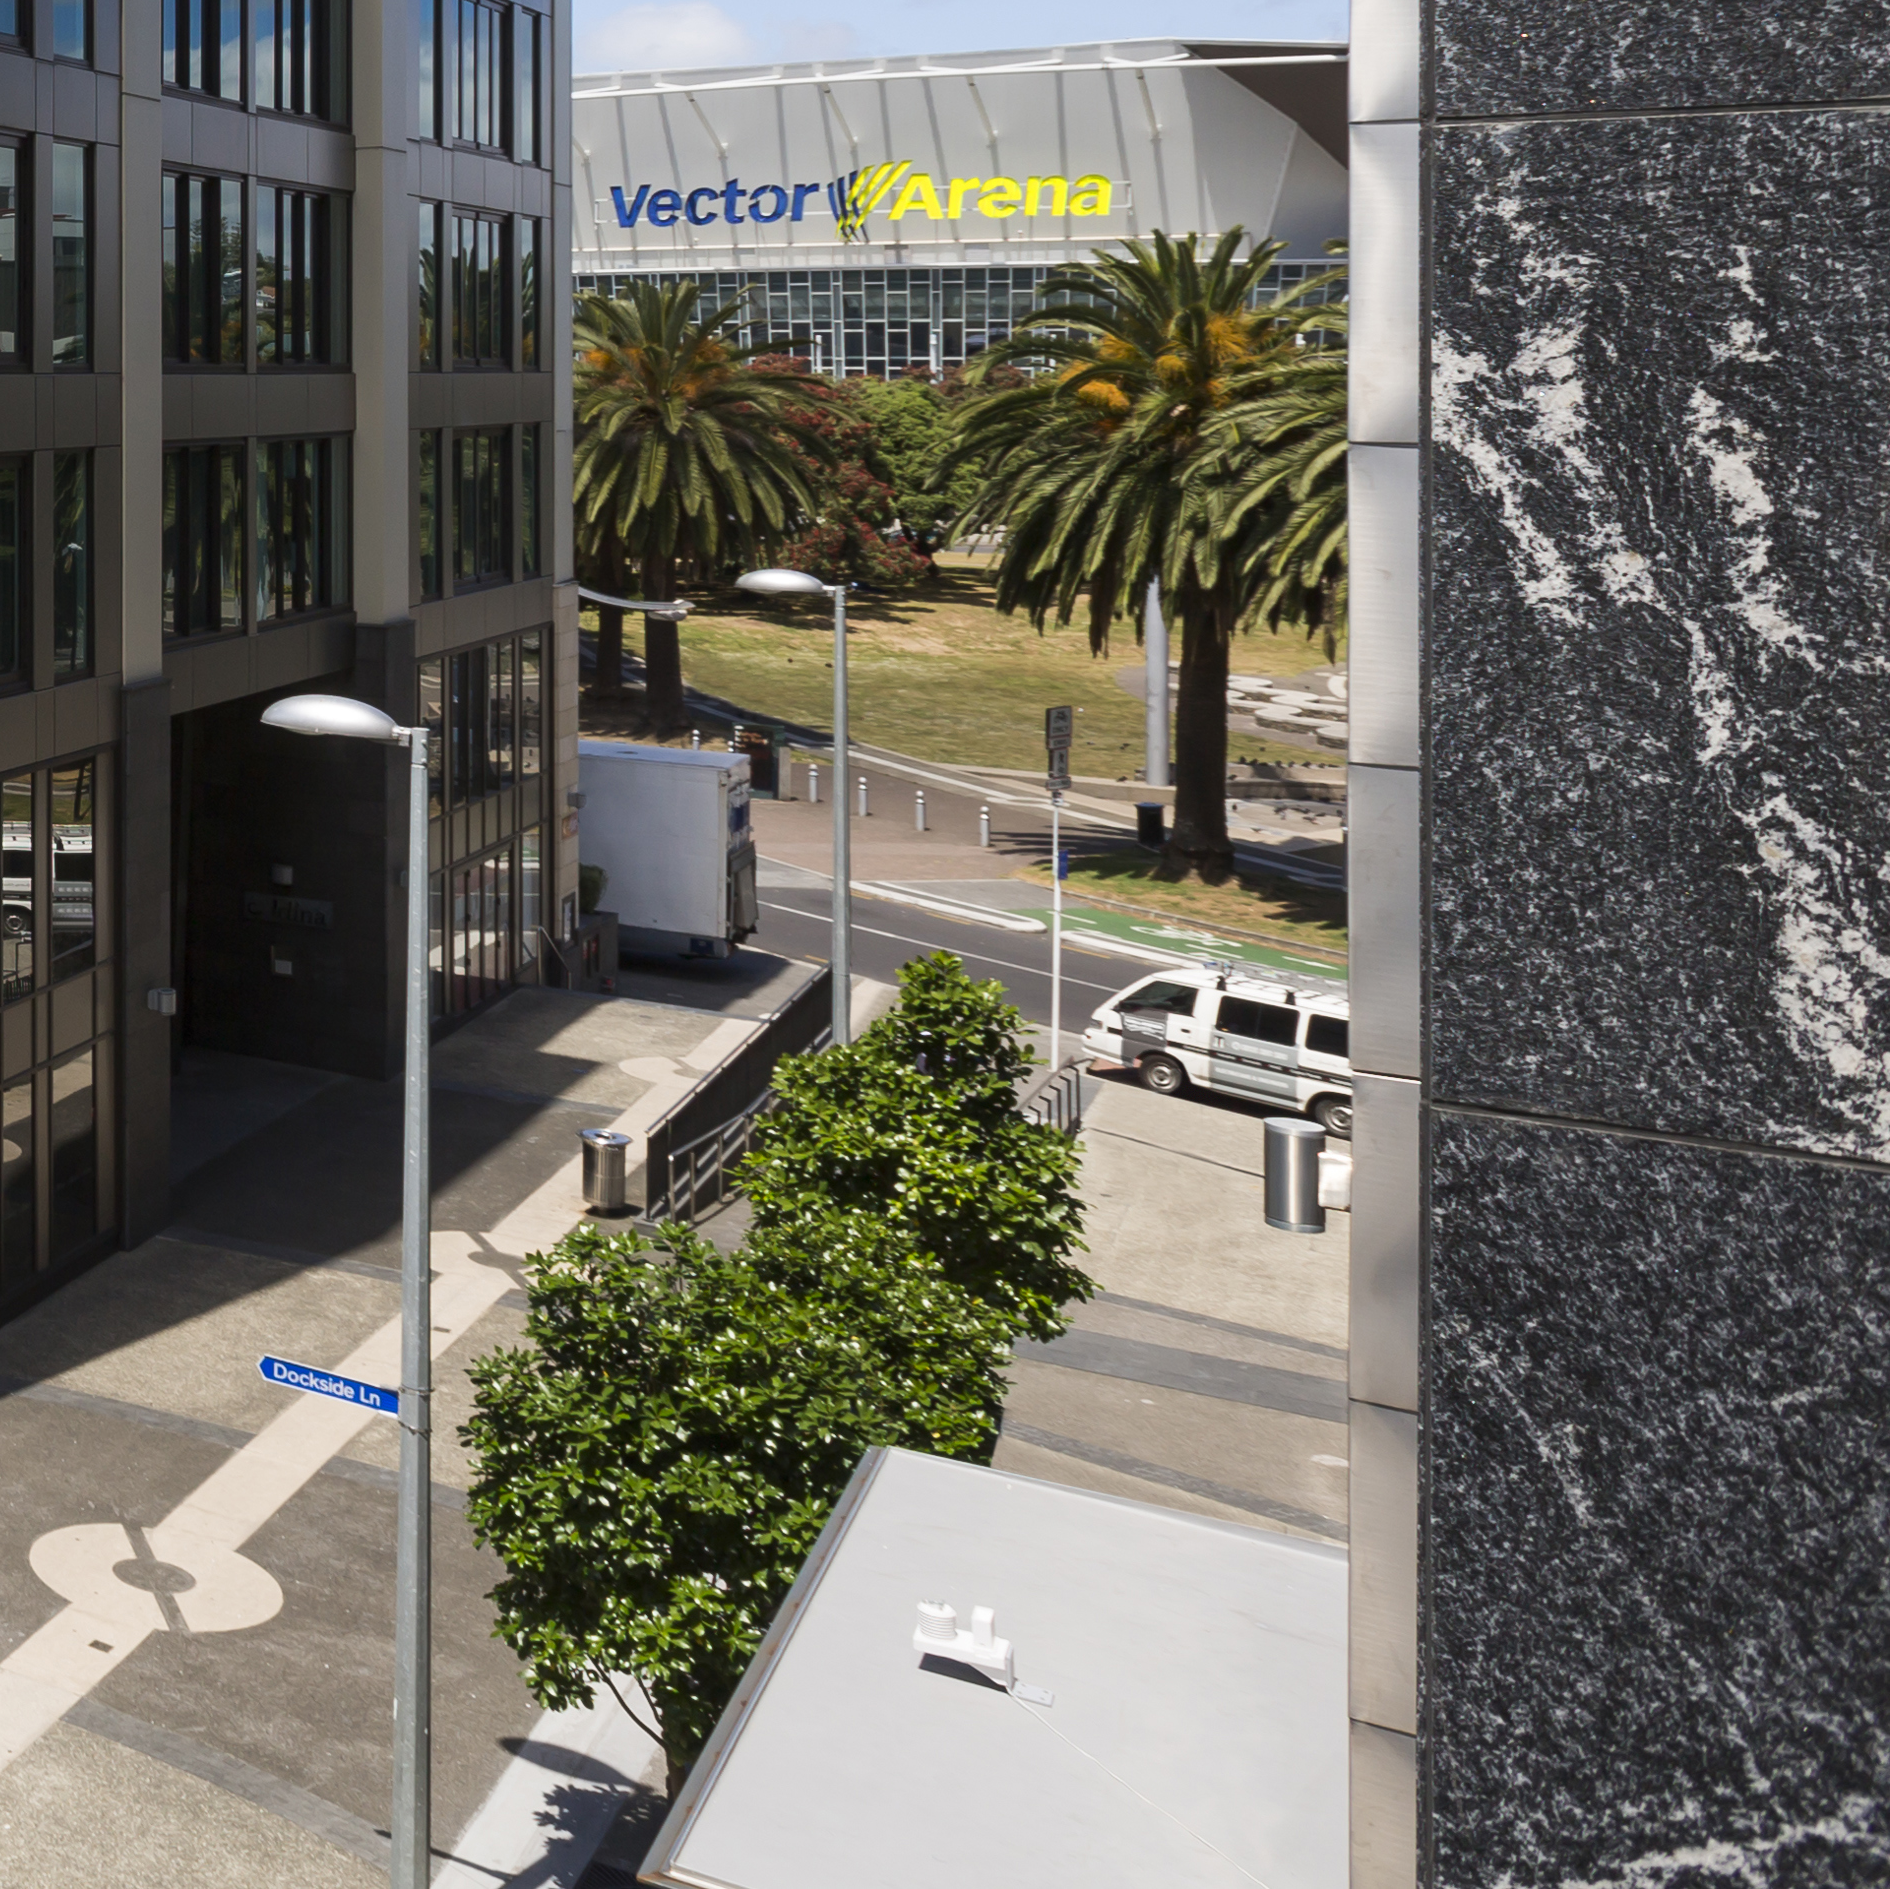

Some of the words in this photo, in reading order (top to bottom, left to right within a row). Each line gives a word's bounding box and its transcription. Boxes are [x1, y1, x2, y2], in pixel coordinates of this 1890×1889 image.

[610, 178, 820, 228] Vector
[888, 173, 1113, 220] Arena
[273, 1362, 355, 1399] Dockside
[359, 1386, 381, 1407] Ln
